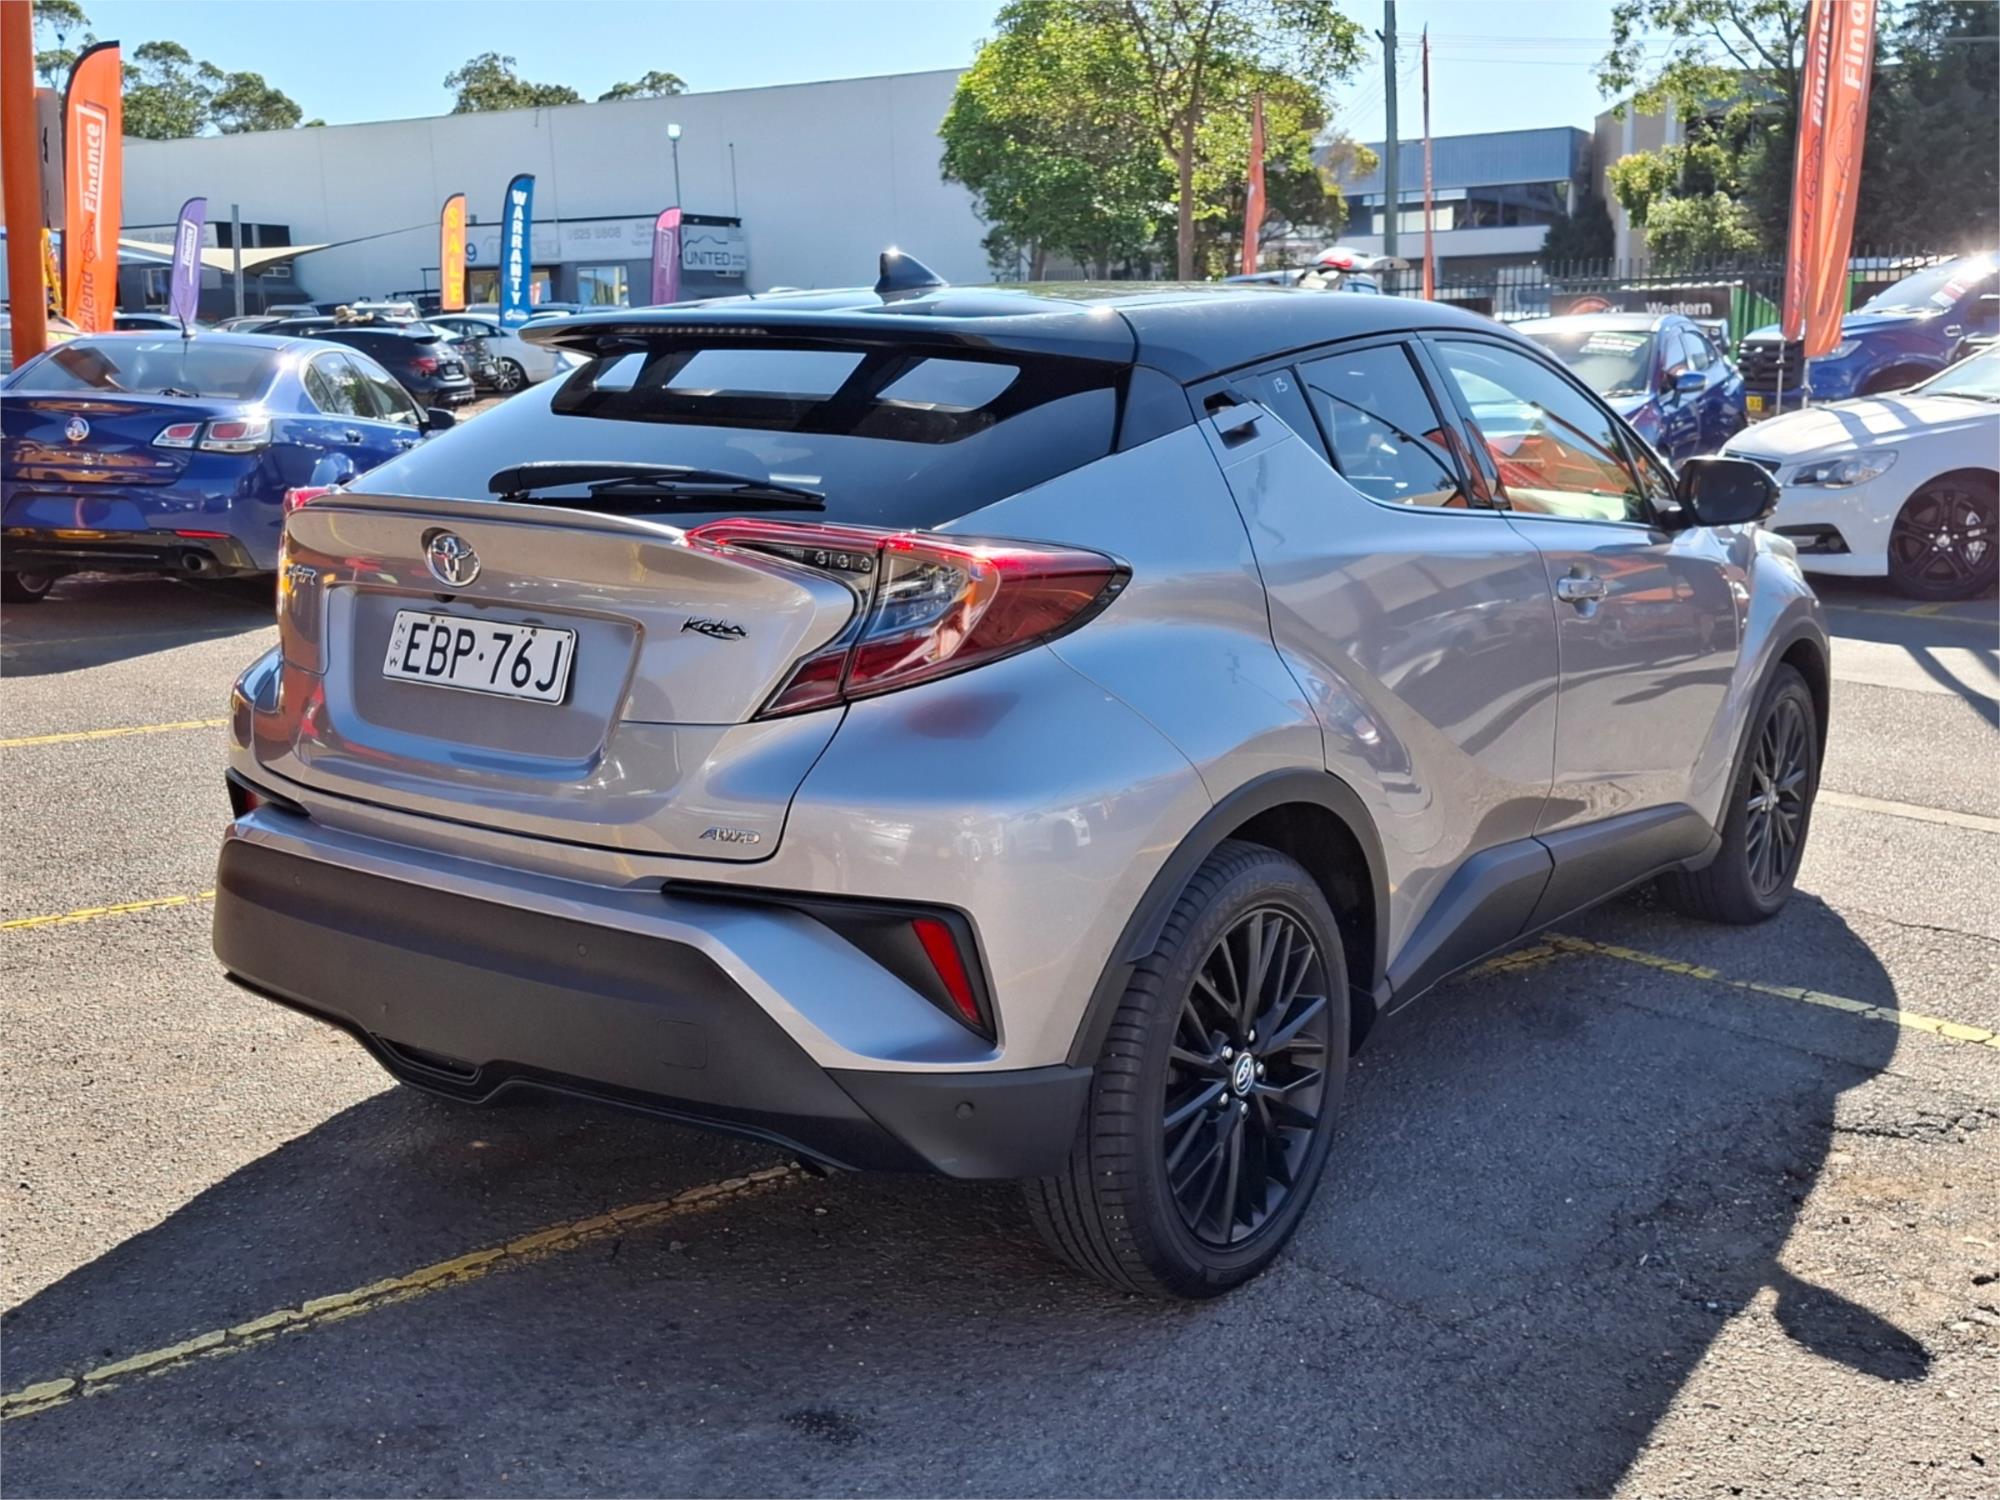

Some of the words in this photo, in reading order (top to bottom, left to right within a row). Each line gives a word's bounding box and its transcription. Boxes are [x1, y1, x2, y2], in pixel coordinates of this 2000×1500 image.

[84, 123, 101, 213] Finance
[447, 207, 461, 303] SALE
[510, 189, 527, 305] WARRANTY
[685, 251, 731, 266] UNITED
[1645, 302, 1713, 316] Western
[681, 616, 747, 641] Koba
[699, 827, 760, 844] AWD
